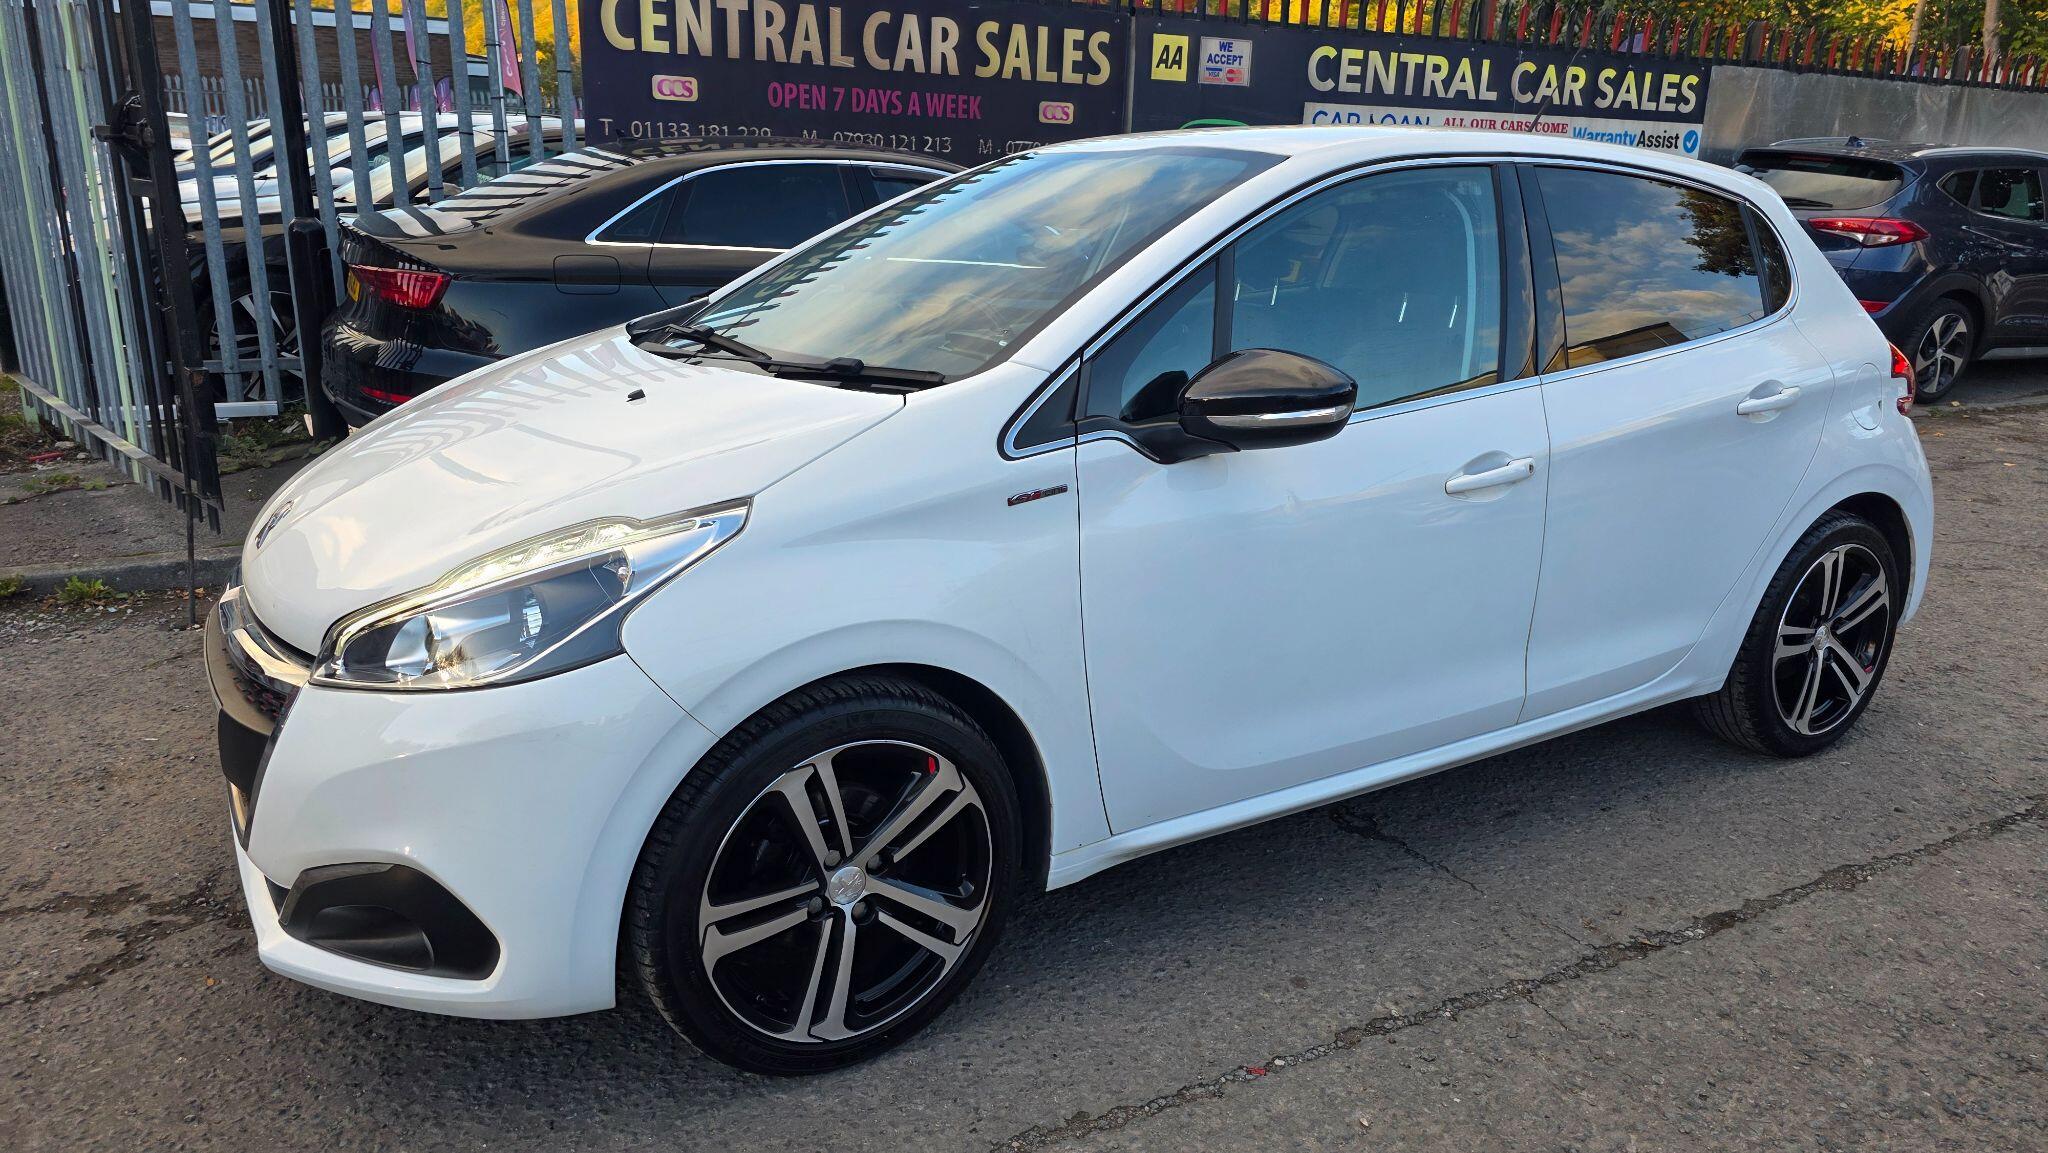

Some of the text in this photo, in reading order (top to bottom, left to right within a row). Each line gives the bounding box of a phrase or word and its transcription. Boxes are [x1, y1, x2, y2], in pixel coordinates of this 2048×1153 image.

[600, 0, 1111, 86] CENTRAL CAR SALES
[1219, 41, 1234, 53] WE
[1156, 44, 1183, 70] AA
[1207, 53, 1243, 66] ACCEPT
[1307, 45, 1700, 114] CENTRAL CAR SALES
[767, 81, 982, 120] OPEN 7 DAYS A WEEK
[631, 120, 690, 138] 01133
[1470, 118, 1497, 130] OUR
[1500, 119, 1531, 132] CARS
[1535, 121, 1569, 134] COME
[890, 134, 916, 151] 121
[922, 135, 952, 153] 213
